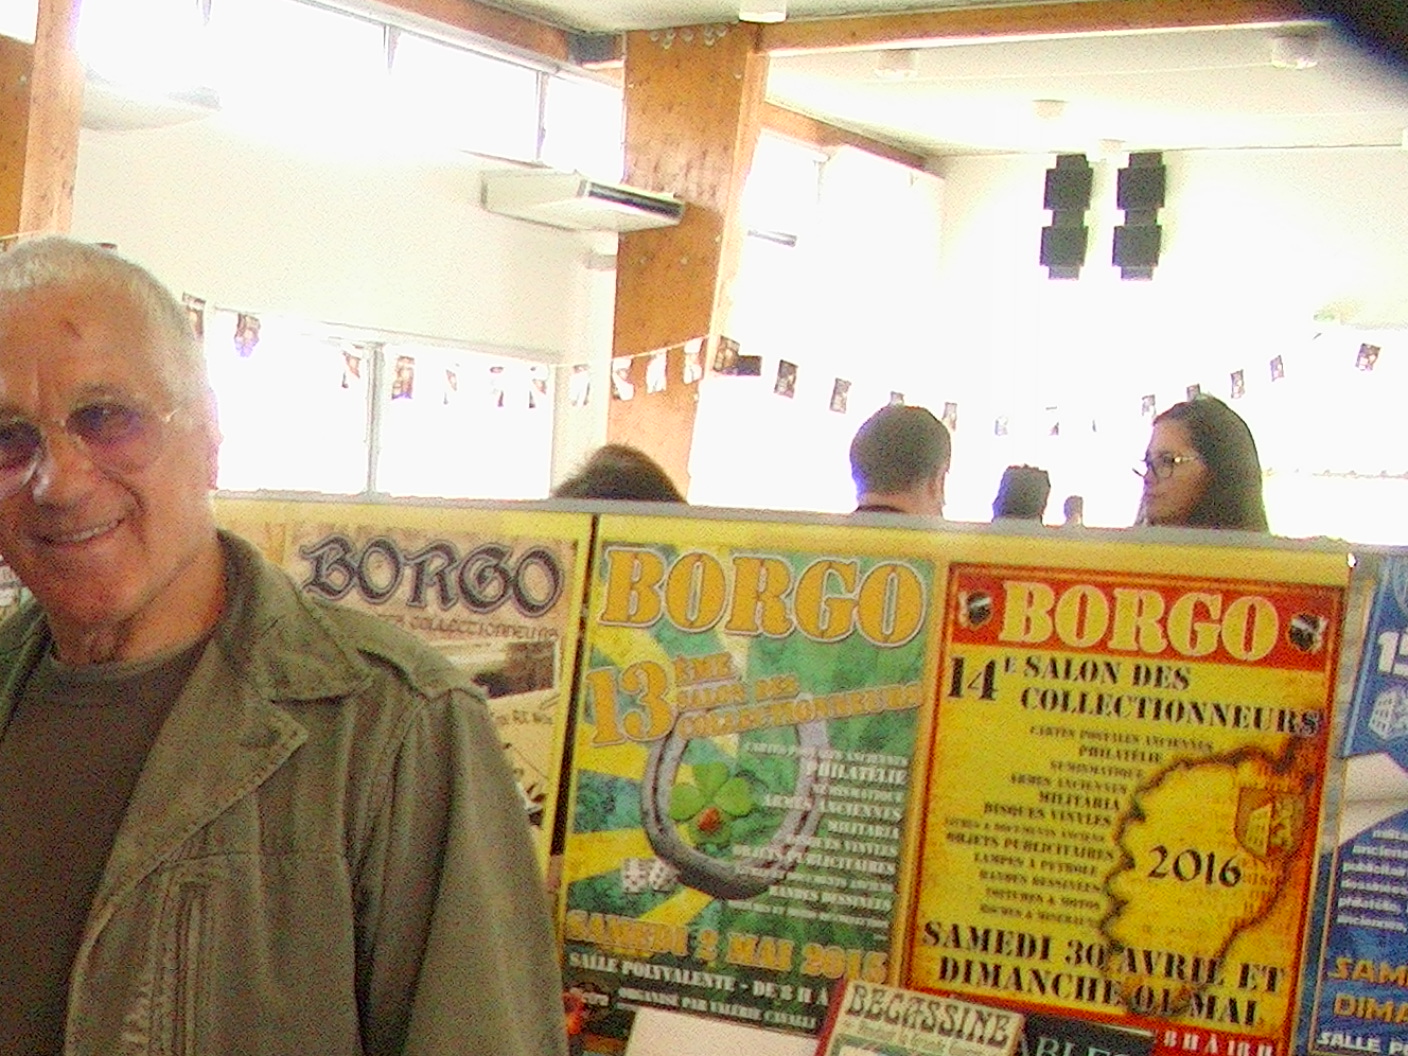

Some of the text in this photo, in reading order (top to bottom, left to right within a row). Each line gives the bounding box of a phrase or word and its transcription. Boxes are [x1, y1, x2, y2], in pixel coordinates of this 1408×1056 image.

[299, 533, 565, 619] BORGO
[598, 546, 927, 648] BORGO
[998, 580, 1280, 662] BORGO
[1022, 655, 1122, 686] SALON
[1130, 662, 1192, 691] DES
[585, 659, 675, 746] 13
[1020, 685, 1323, 736] COLLECTIONNEURS
[805, 758, 908, 785] PHILATÉLIE
[827, 820, 900, 839] MILITARIA
[1147, 844, 1243, 889] 2016
[568, 950, 618, 974] SALLE
[619, 958, 736, 993] POLYVALENTE
[921, 919, 1285, 994] SAMEDI 30 AVRIL ET
[845, 984, 1014, 1047] BECASSINE
[938, 955, 1123, 1007] DIMANCHE
[1188, 993, 1260, 1027] MAI
[1317, 1030, 1382, 1053] SALLE
